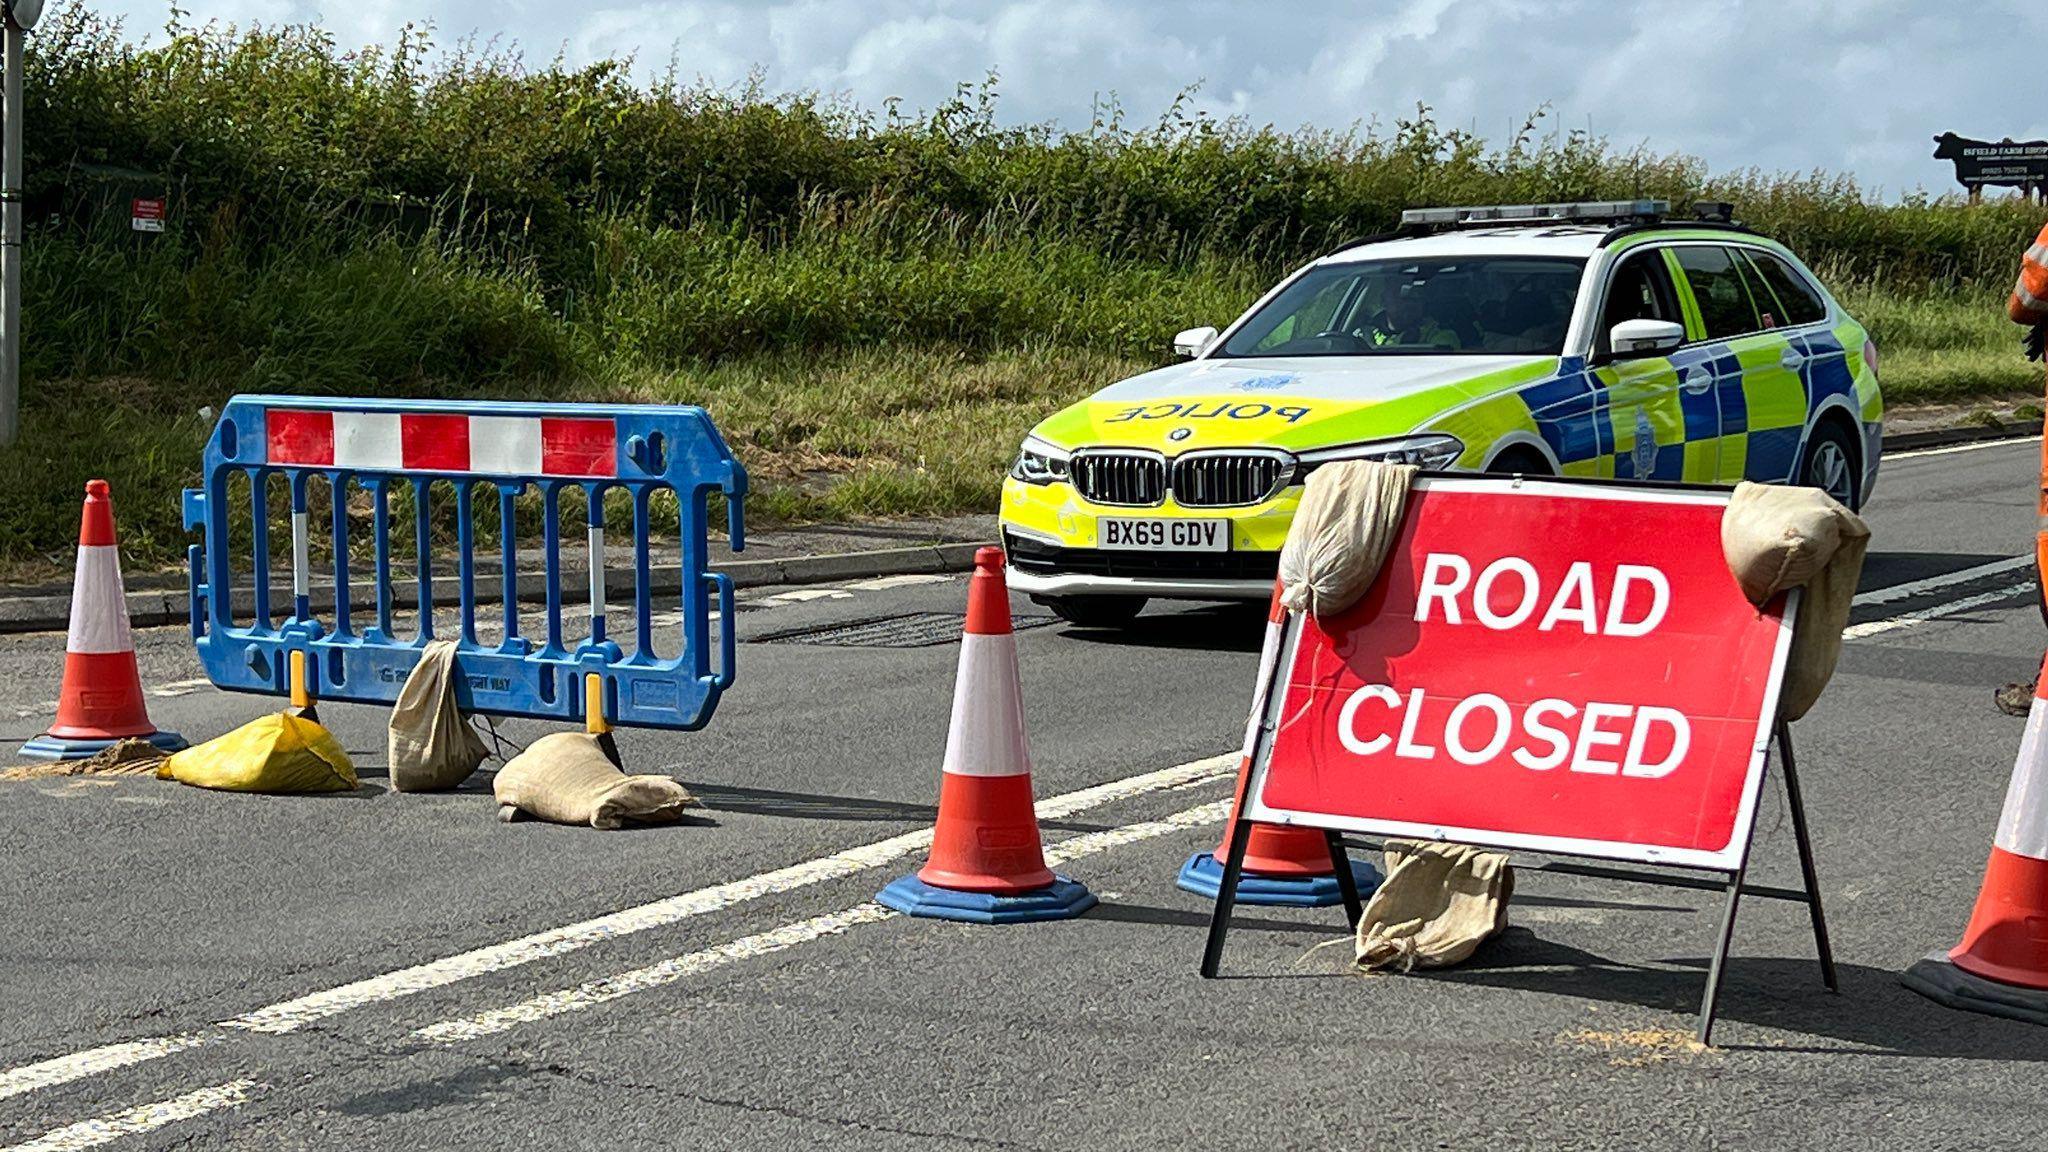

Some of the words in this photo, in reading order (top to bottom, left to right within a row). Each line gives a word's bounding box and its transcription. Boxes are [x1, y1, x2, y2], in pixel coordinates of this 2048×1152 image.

[1106, 520, 1165, 546] BX69
[1171, 521, 1217, 547] GDV
[1413, 552, 1670, 638] ROAD
[1337, 684, 1691, 779] CLOSED
